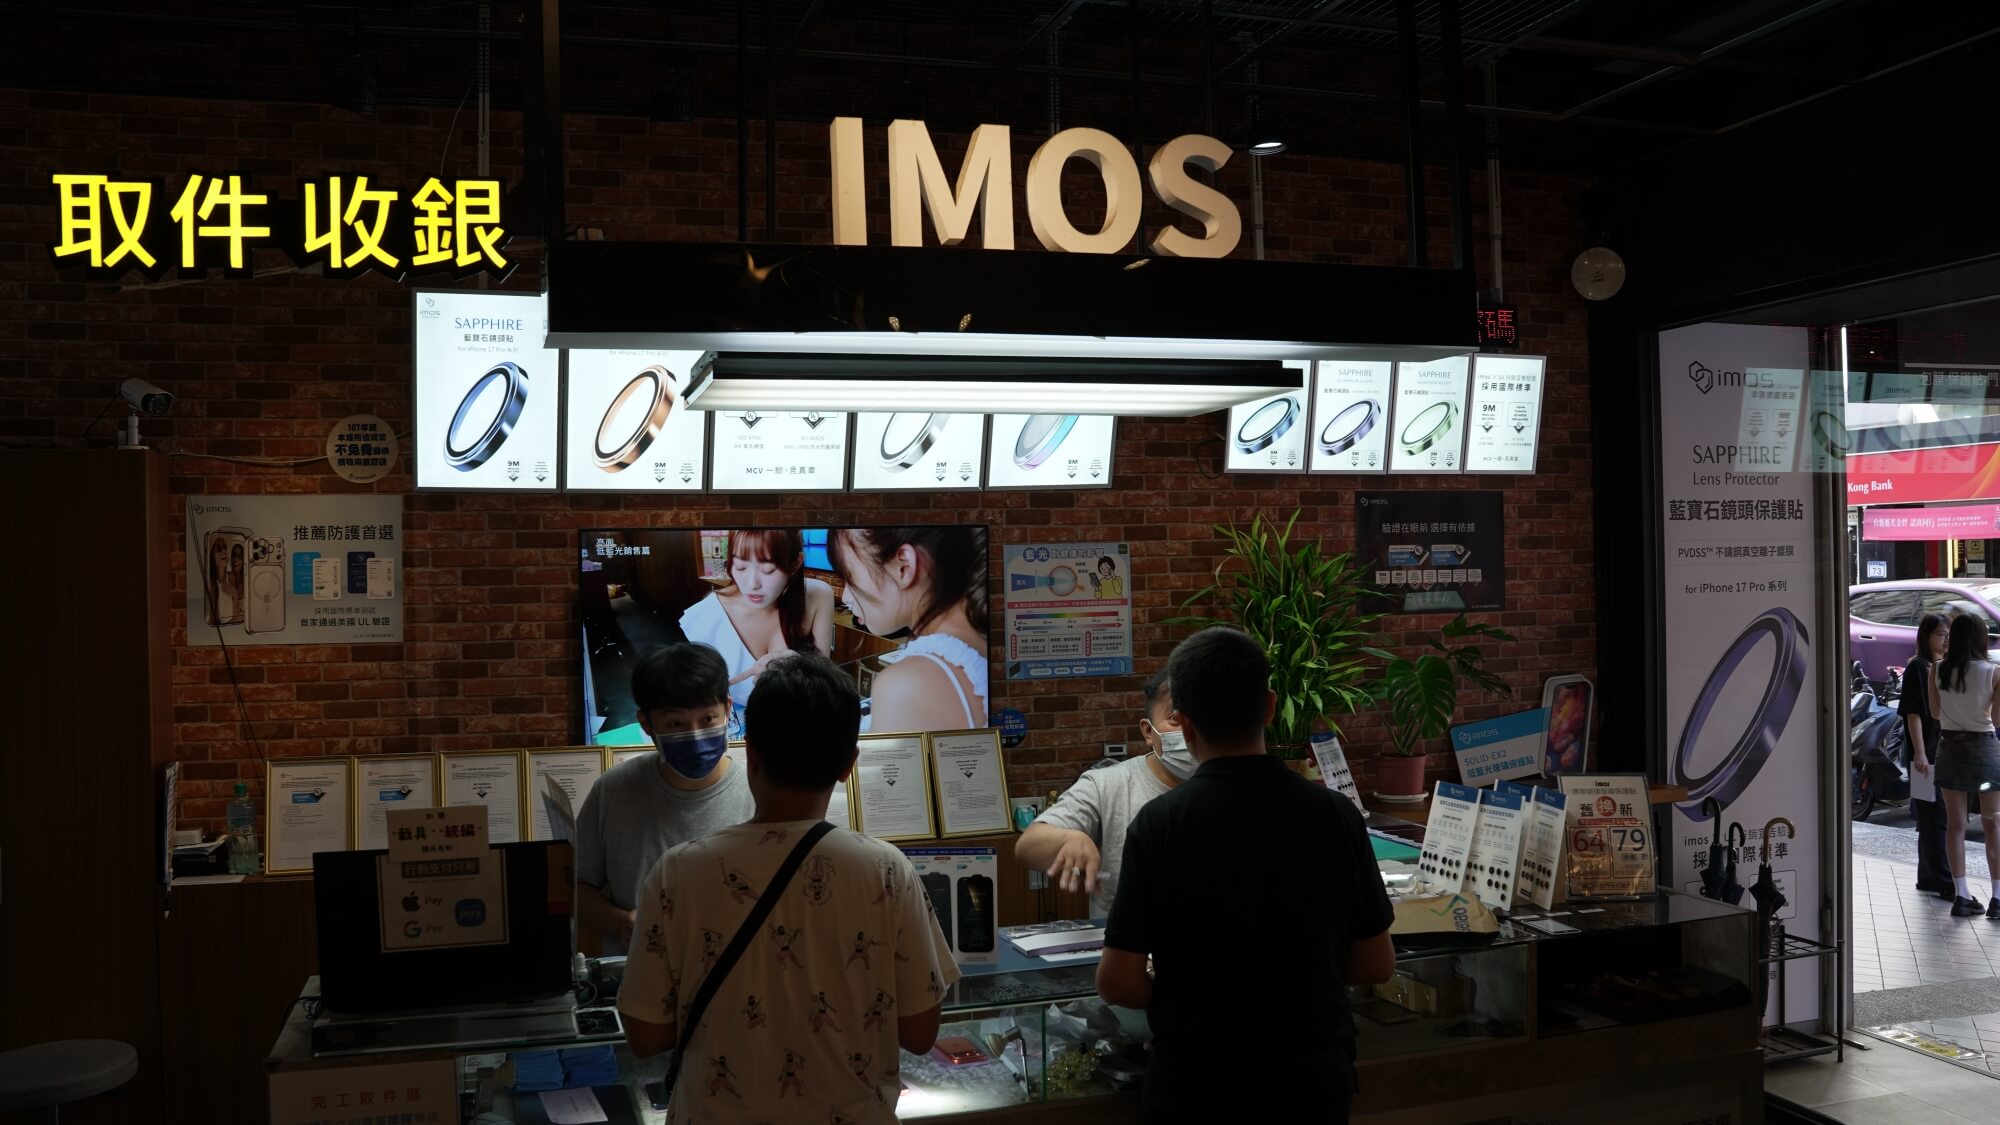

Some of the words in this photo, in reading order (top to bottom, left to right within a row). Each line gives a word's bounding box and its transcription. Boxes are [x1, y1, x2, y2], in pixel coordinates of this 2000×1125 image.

[830, 117, 1243, 258] IMOS
[52, 174, 271, 270] 取件
[303, 176, 508, 270] 收銀
[454, 317, 524, 331] SAPPHIRE
[463, 333, 514, 344] 藍寶石鏡頭貼
[1338, 368, 1373, 377] SAPPHIRE
[1418, 371, 1452, 379] SAPPHIRE
[1718, 370, 1774, 388] imos
[1481, 382, 1532, 392] 採用國際標準
[1483, 404, 1496, 412] 9M
[1693, 445, 1782, 464] SAPPHIRE
[1693, 472, 1721, 485] Lens
[1725, 472, 1780, 486] Protector
[1847, 482, 1869, 494] Kong
[1871, 479, 1893, 491] Bank
[207, 505, 232, 513] imos
[1669, 499, 1804, 521] 藍寶石鏡頭保護貼
[293, 525, 395, 541] 推薦防護首選
[1872, 567, 1882, 575] 73
[1685, 584, 1697, 594] for
[1699, 583, 1733, 593] iPhone
[1736, 582, 1746, 592] 17
[1749, 582, 1766, 592] Pro
[1768, 580, 1787, 593] 系列
[358, 618, 371, 626] UL
[1472, 728, 1498, 741] imos
[1464, 749, 1507, 766] SOLID-EX2
[1573, 829, 1606, 853] 64
[1613, 829, 1646, 852] 79
[1684, 834, 1710, 848] imos
[425, 897, 441, 906] Pay
[426, 925, 442, 933] Pay
